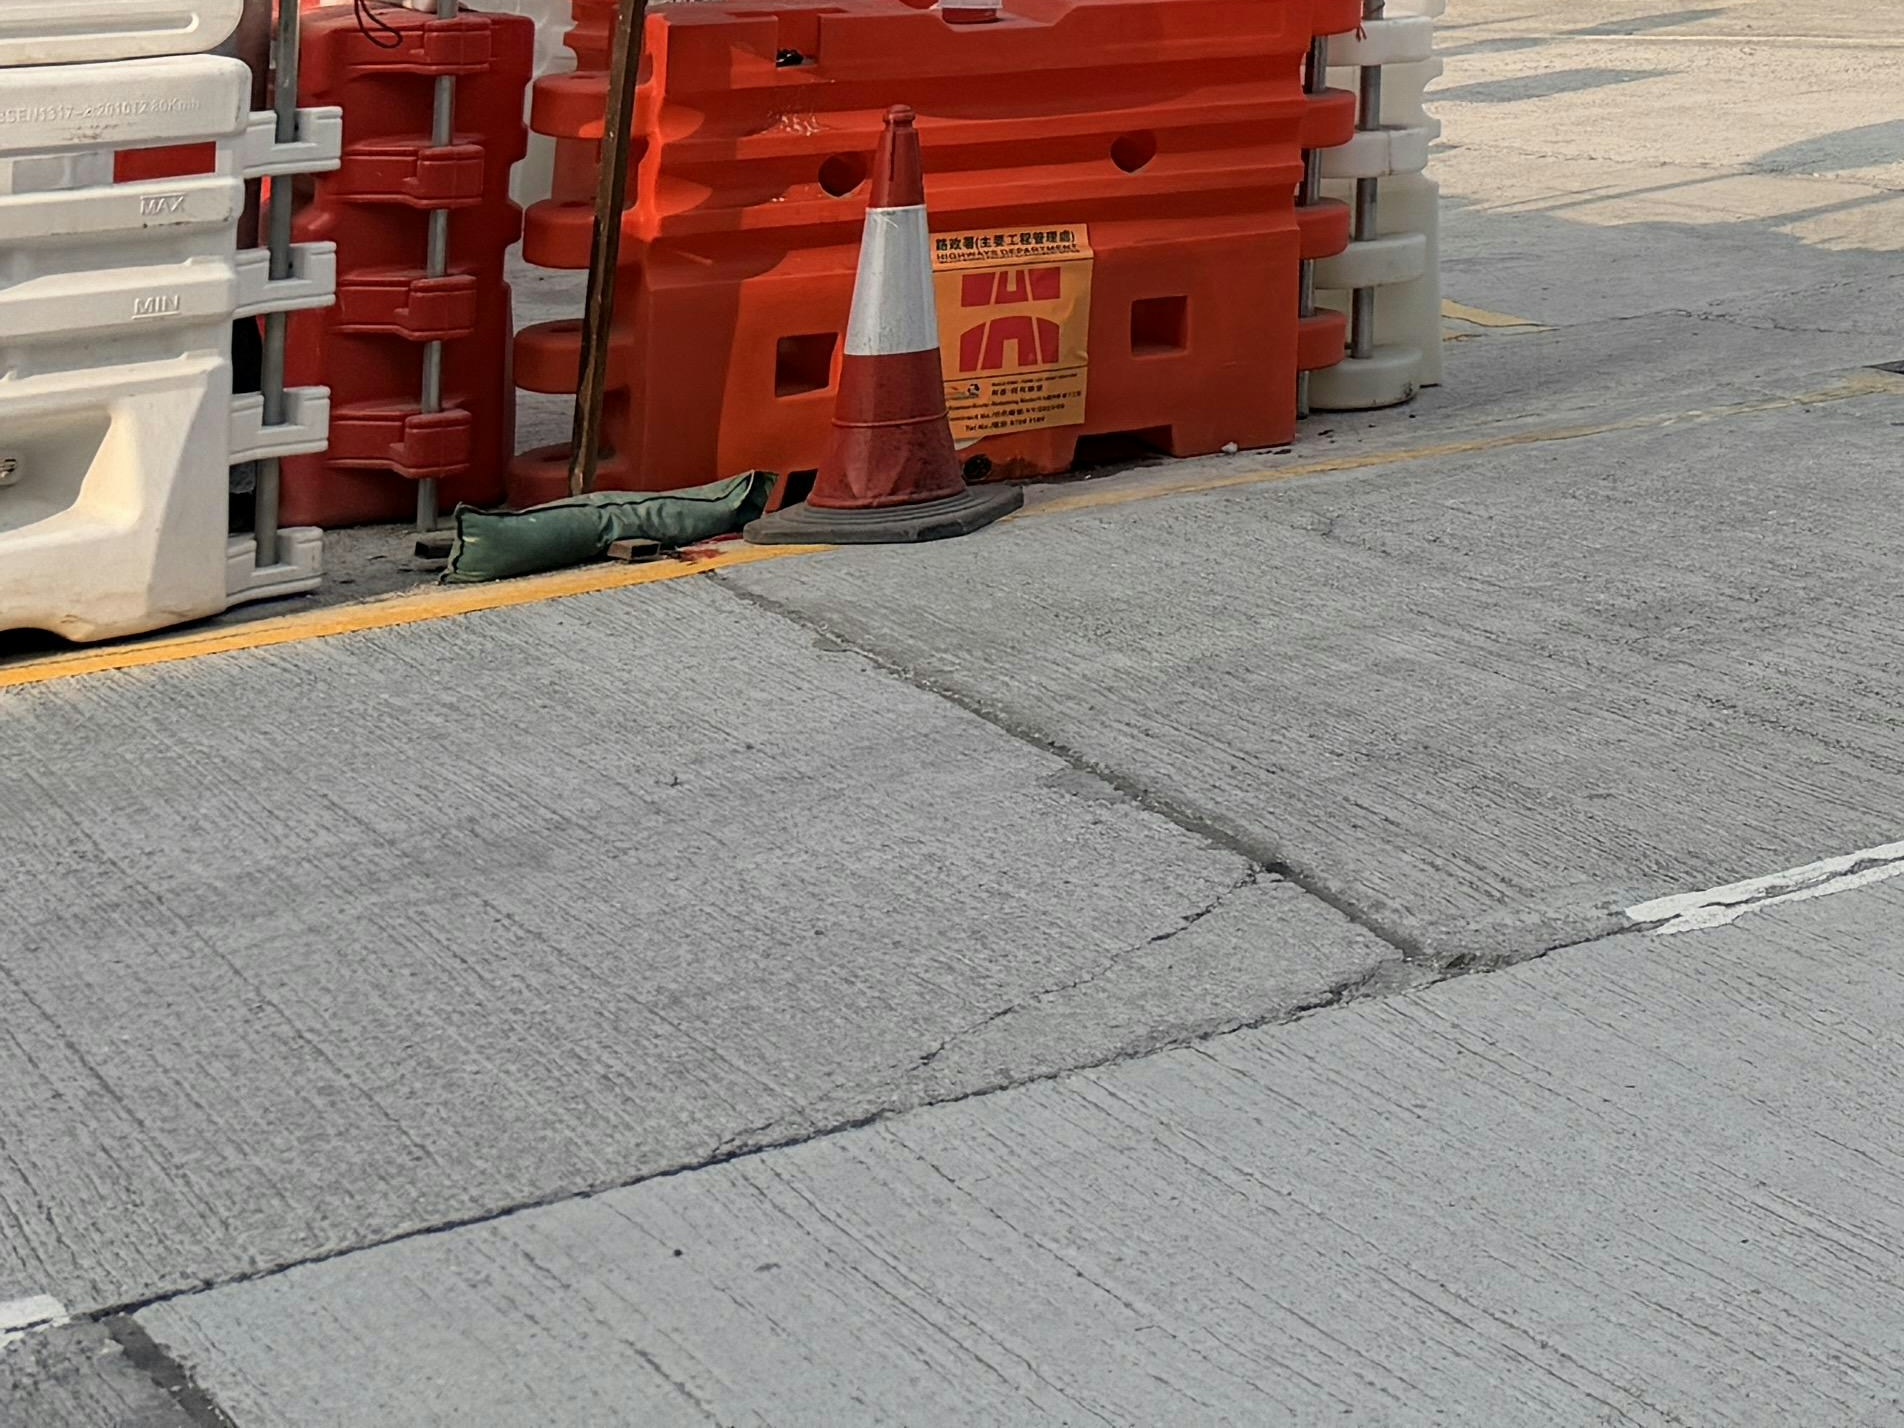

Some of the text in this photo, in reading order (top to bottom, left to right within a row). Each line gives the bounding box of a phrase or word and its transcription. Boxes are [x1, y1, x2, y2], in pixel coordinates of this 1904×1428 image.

[139, 195, 185, 215] MAX
[936, 249, 999, 261] HIGHWAYS
[1000, 243, 1078, 258] DEPARTMENT
[134, 295, 180, 313] MIN
